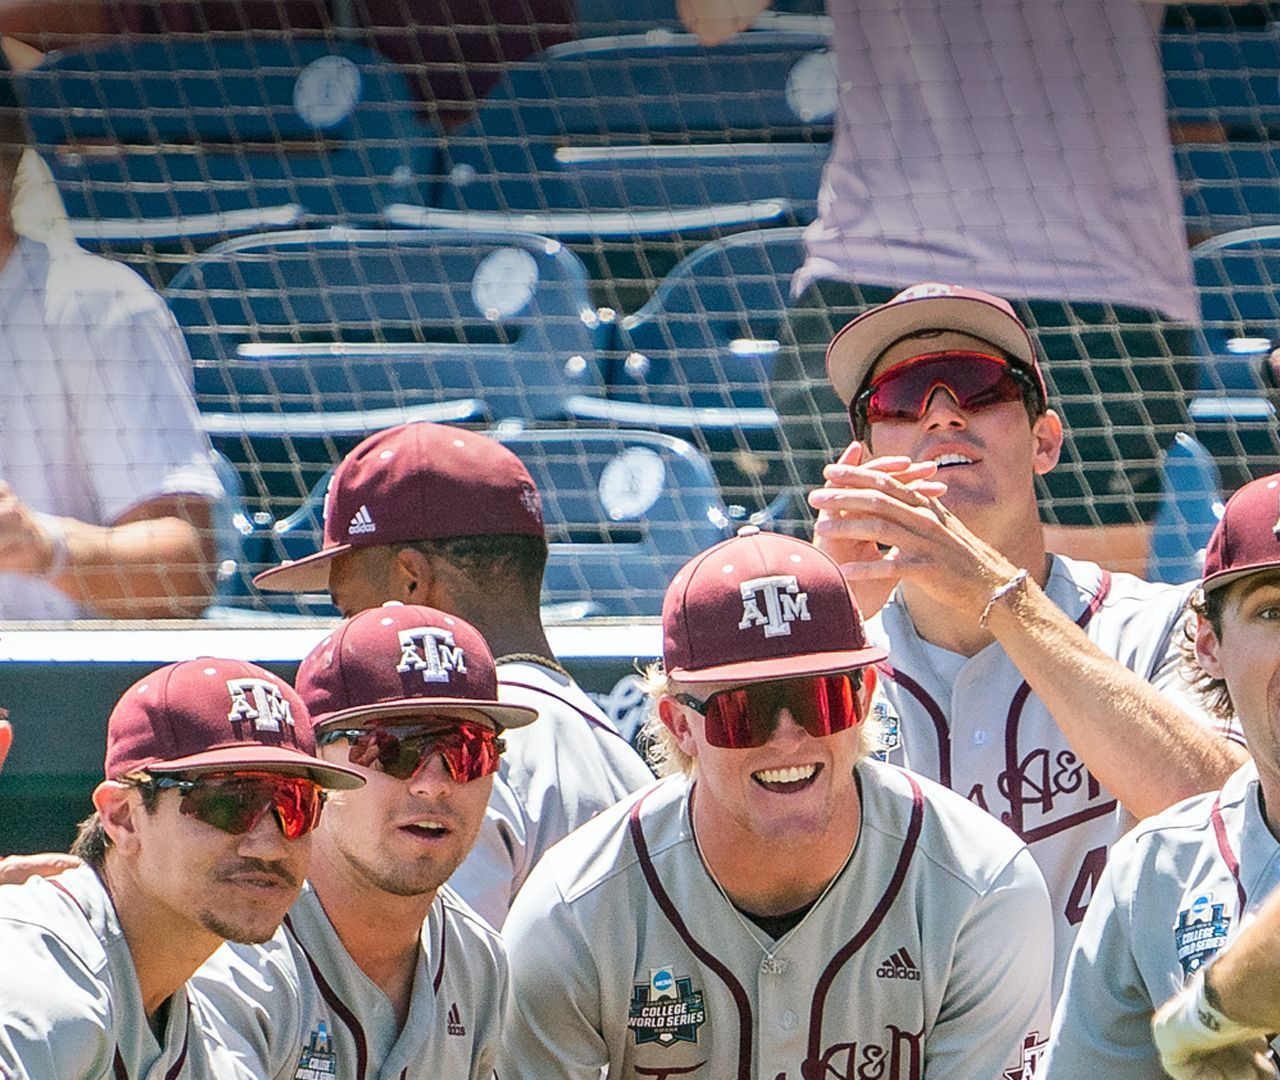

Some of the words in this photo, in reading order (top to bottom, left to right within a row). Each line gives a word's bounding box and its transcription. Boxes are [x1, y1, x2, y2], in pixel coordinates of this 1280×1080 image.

[641, 1003, 688, 1018] COLLEGE
[627, 1016, 665, 1028] WORLD
[666, 1011, 704, 1027] SERIES
